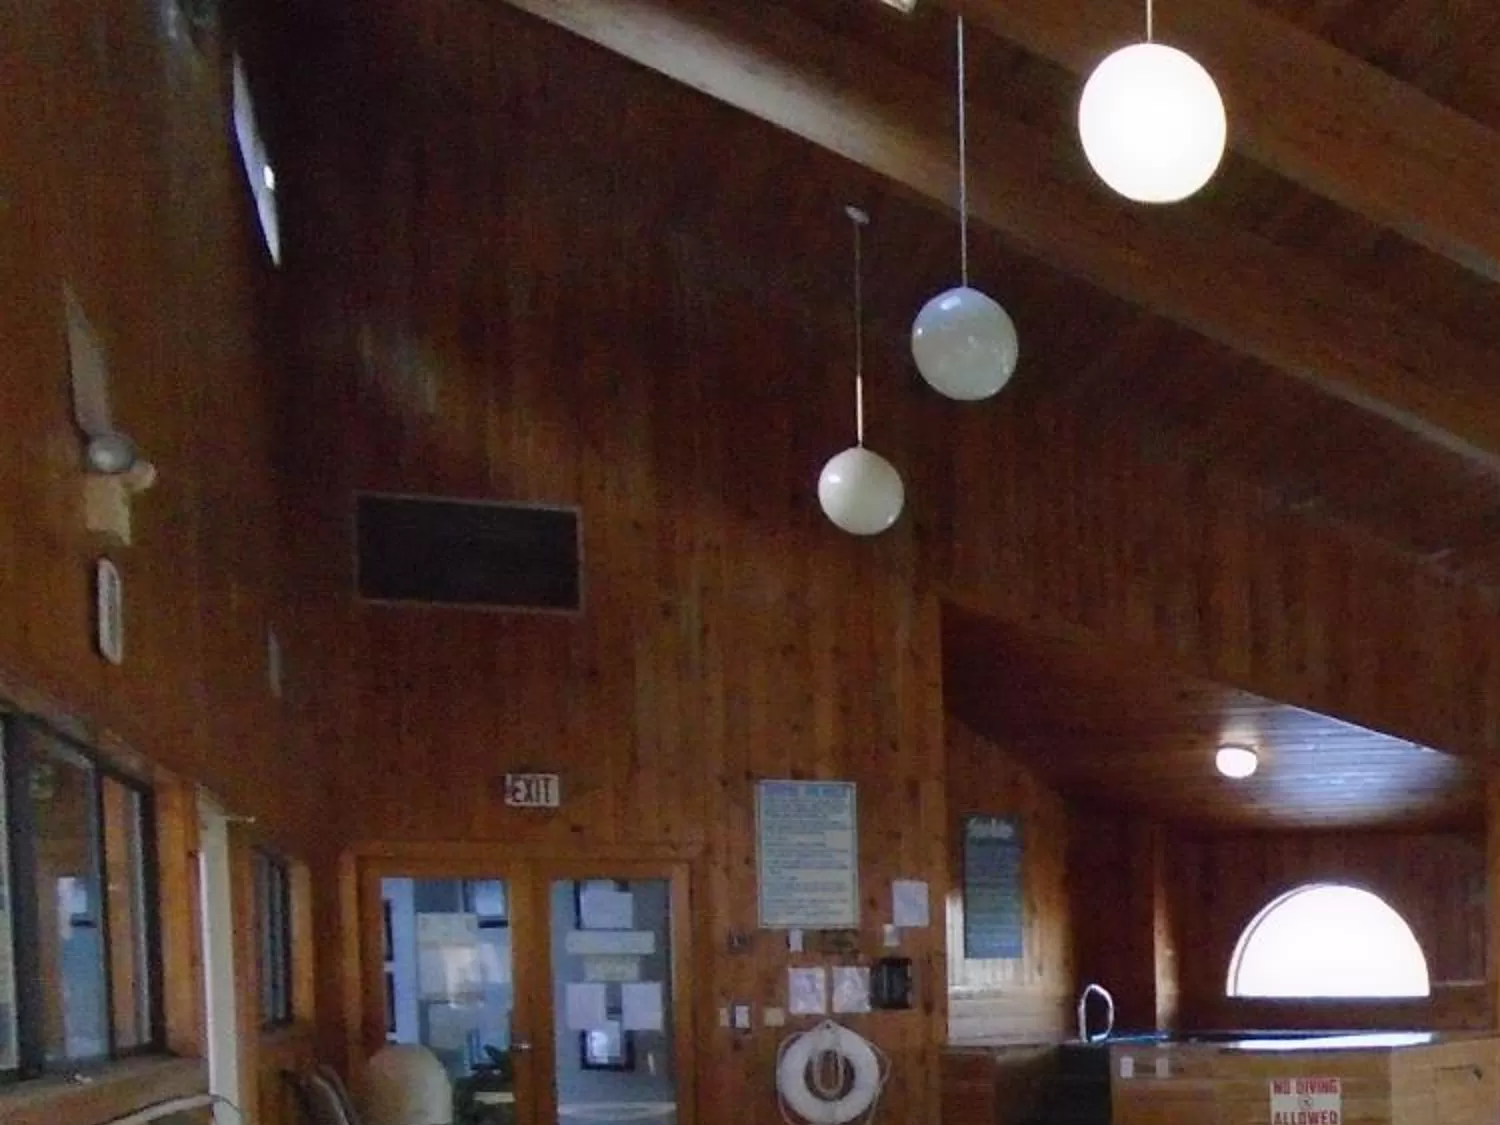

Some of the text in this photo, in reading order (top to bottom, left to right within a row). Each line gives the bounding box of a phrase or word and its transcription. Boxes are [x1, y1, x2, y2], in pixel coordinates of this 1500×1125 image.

[509, 776, 556, 804] EXIT
[1273, 1078, 1339, 1095] NO DIVING
[1274, 1109, 1338, 1125] ALLOWED
